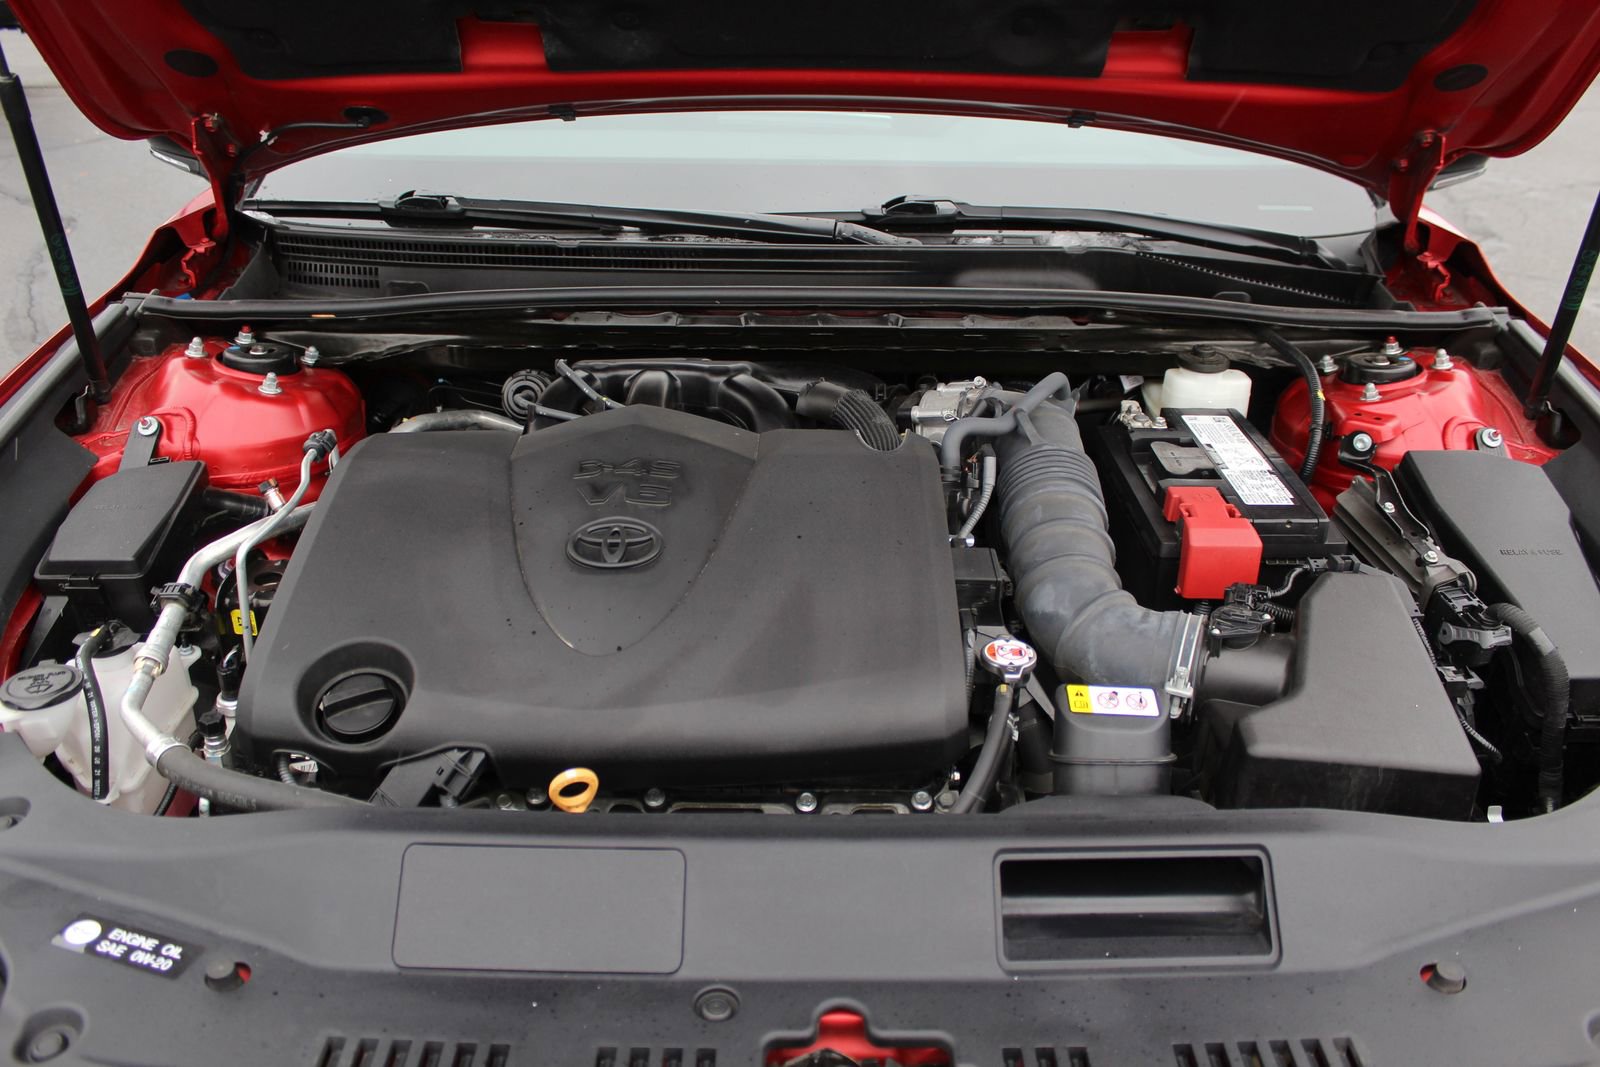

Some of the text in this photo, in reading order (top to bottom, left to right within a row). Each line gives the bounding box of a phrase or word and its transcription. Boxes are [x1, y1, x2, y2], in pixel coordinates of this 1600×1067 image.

[575, 480, 673, 507] V6
[95, 939, 128, 957] SAE
[107, 927, 184, 960] ENGINE OIL
